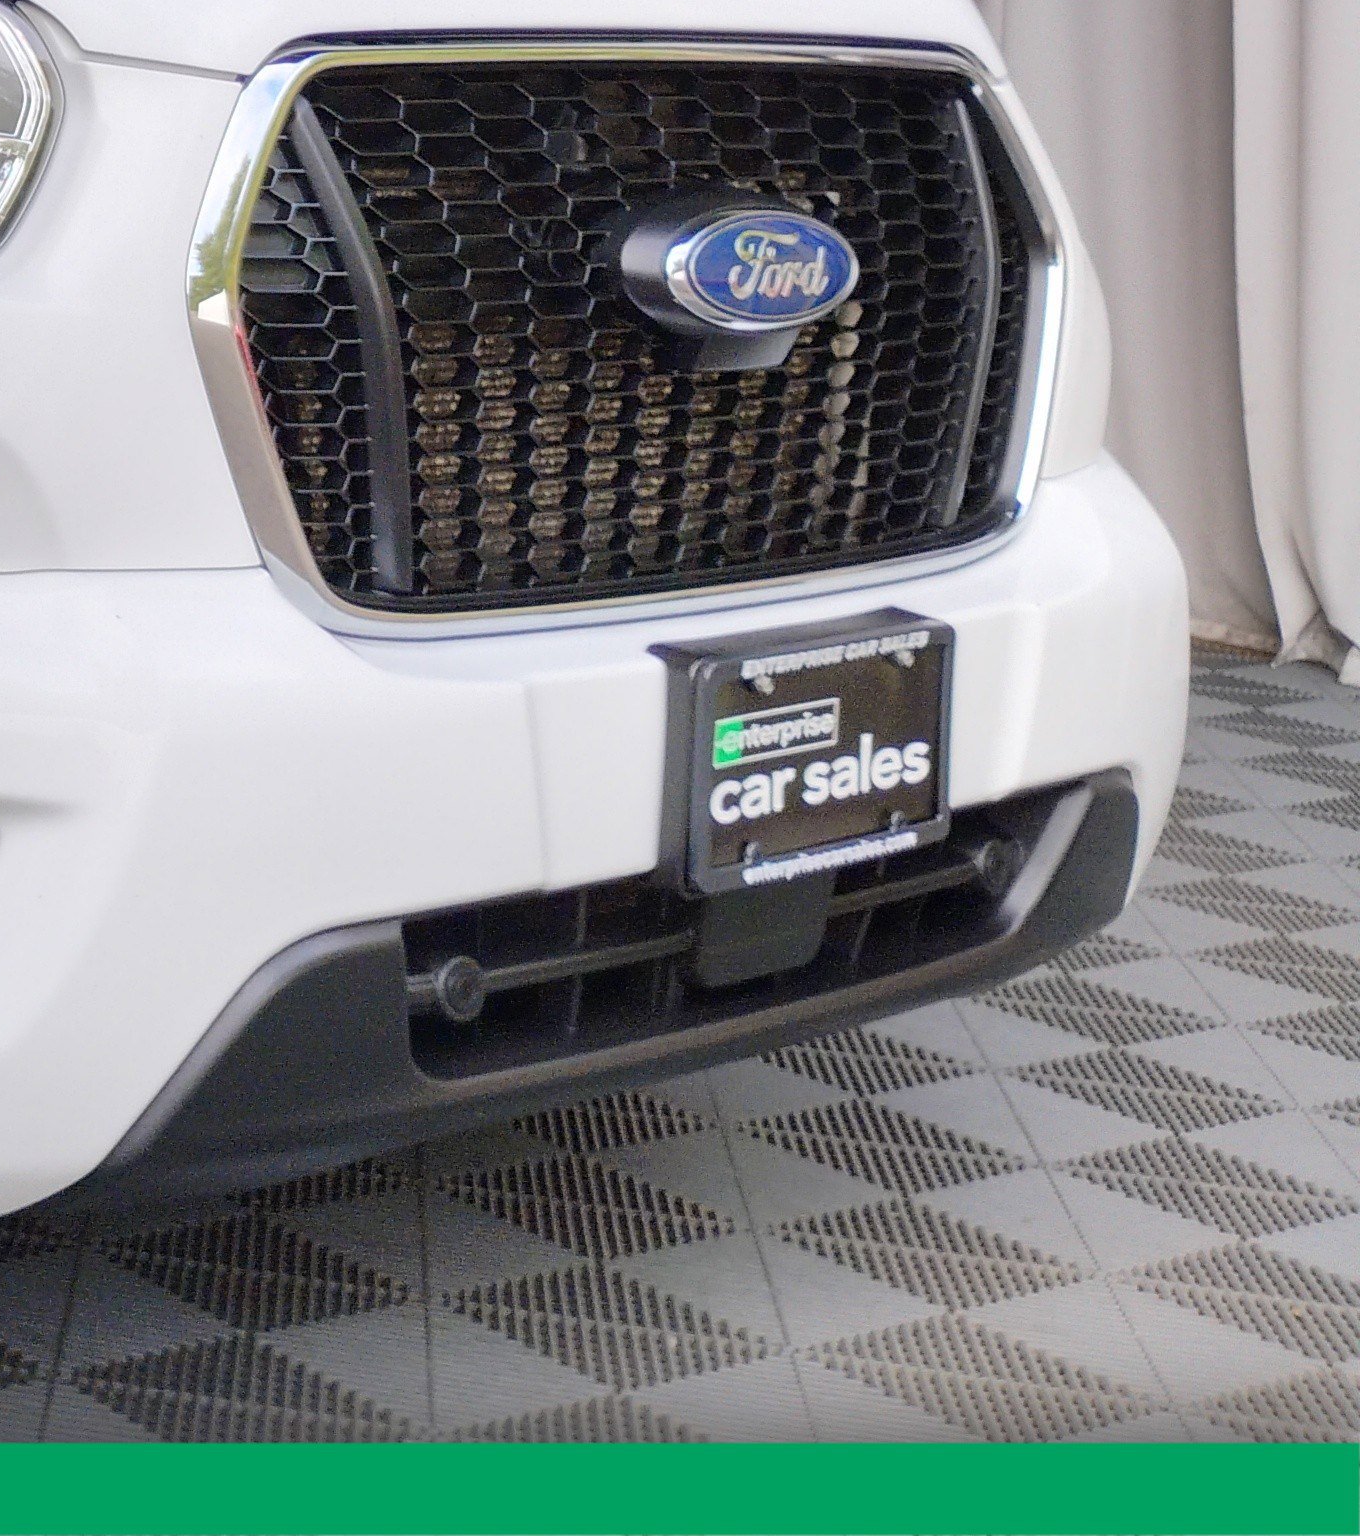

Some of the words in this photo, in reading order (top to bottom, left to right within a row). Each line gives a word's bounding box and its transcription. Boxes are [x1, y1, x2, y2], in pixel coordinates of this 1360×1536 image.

[728, 229, 829, 300] Ford
[718, 711, 836, 754] enterprise
[709, 767, 796, 824] car
[802, 733, 931, 805] sales
